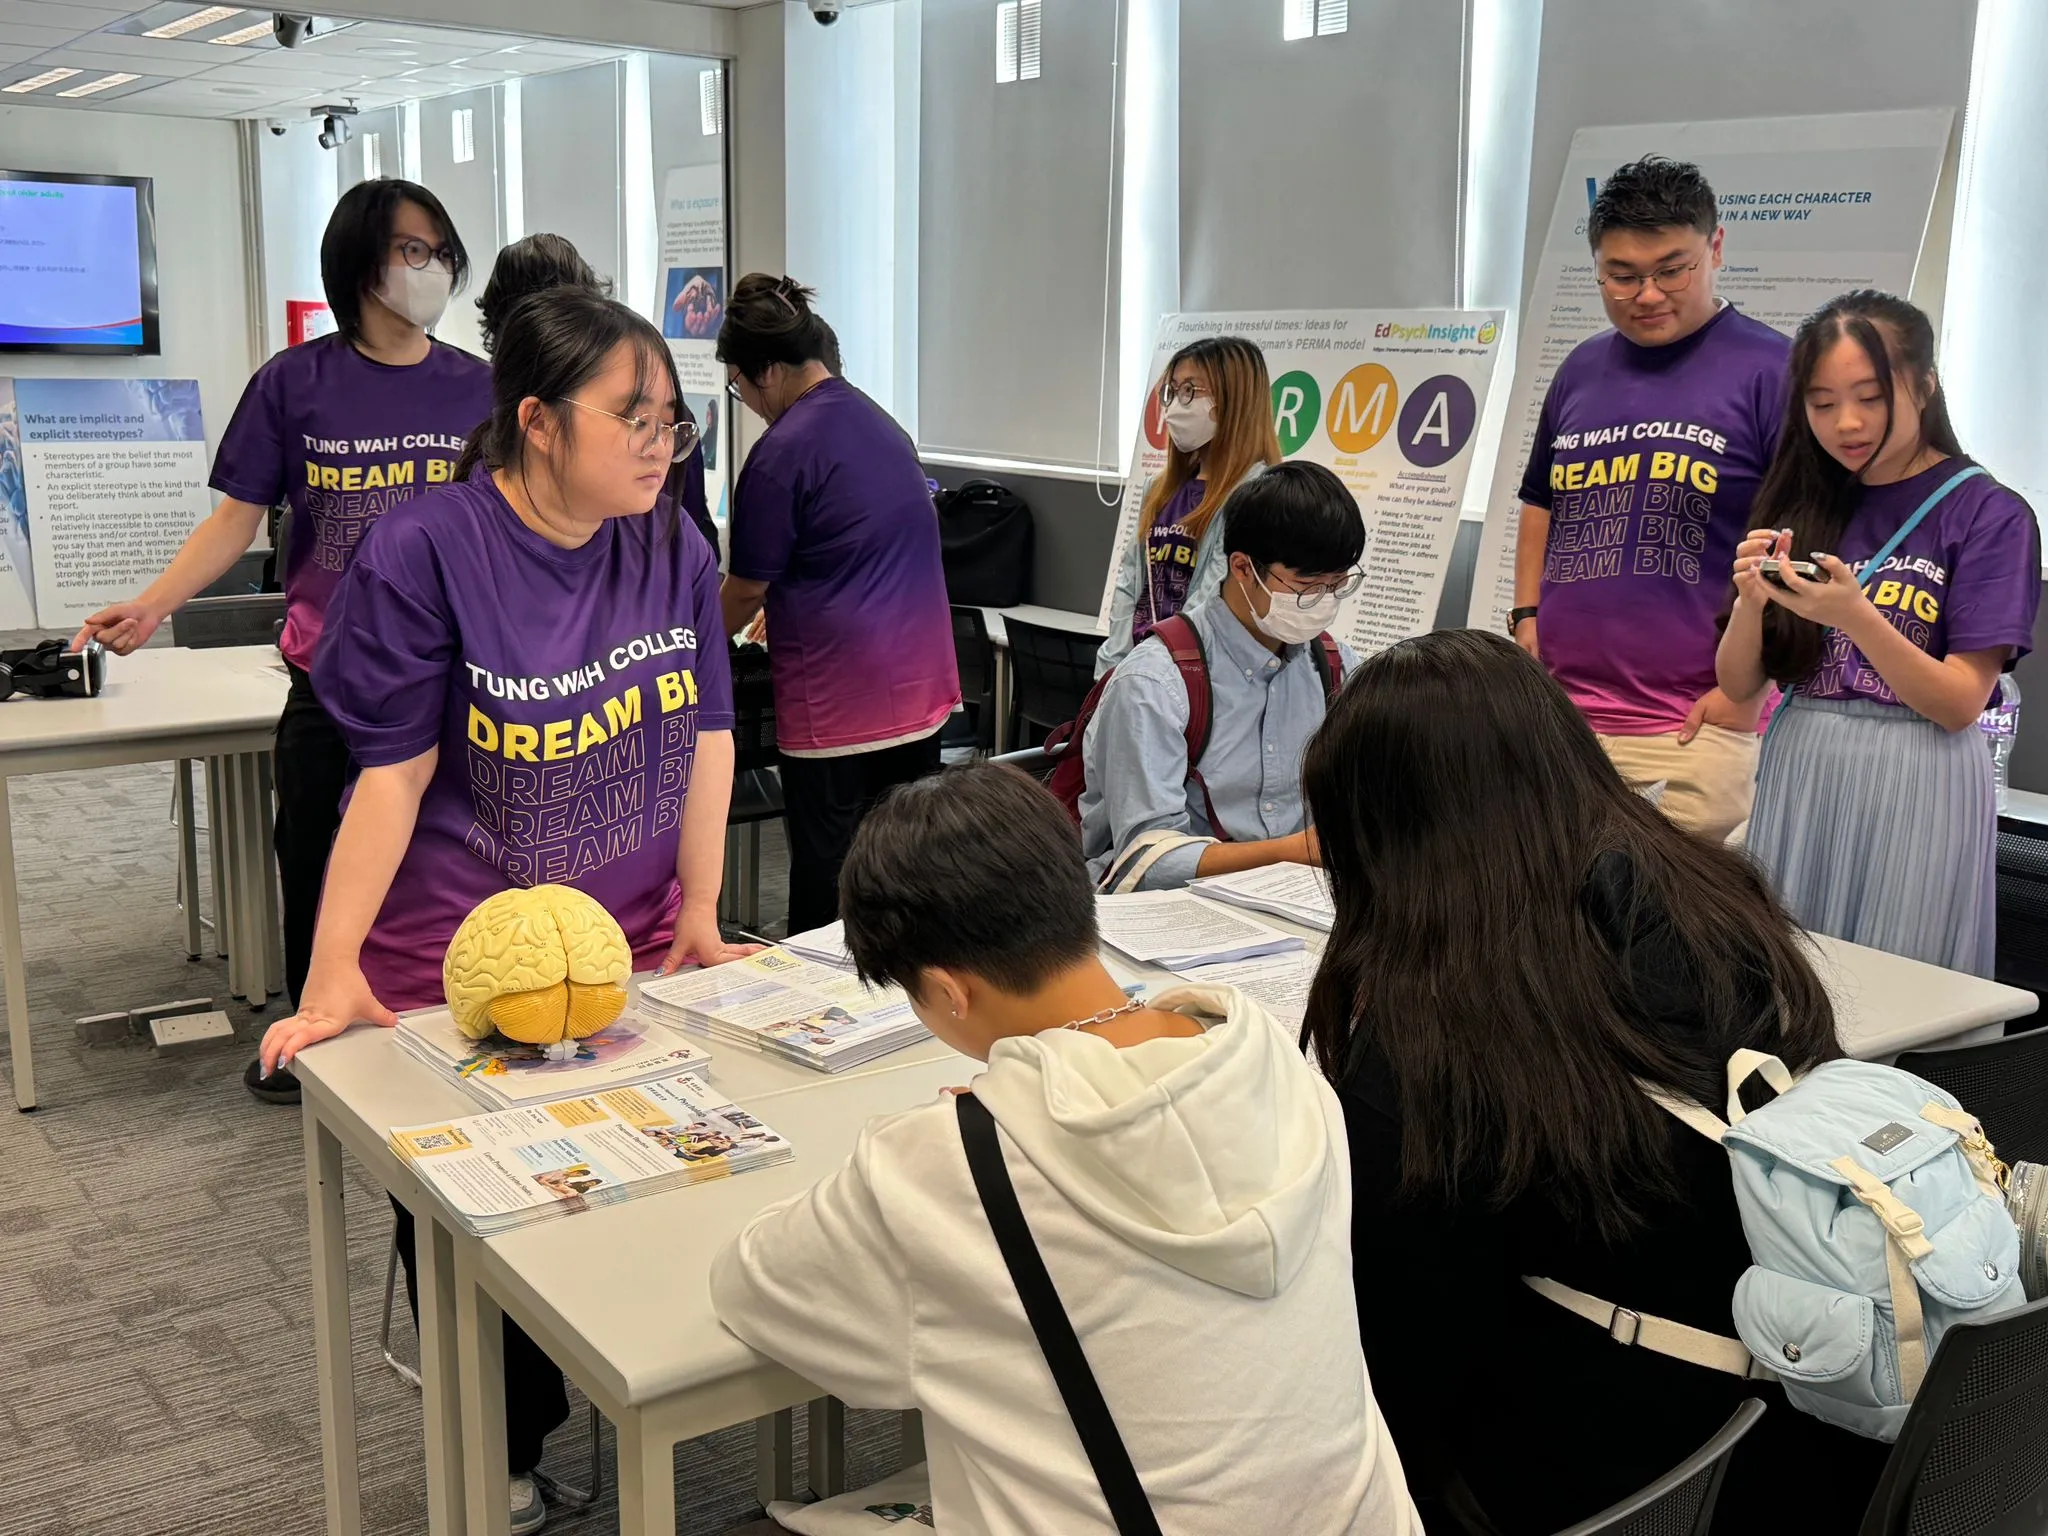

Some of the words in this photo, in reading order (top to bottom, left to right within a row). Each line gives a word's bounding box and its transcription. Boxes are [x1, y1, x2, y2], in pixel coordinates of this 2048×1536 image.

[1719, 195, 1756, 205] USING
[1759, 194, 1791, 204] EACH
[1795, 192, 1872, 204] CHARACTER
[1725, 211, 1737, 221] IN
[1739, 211, 1749, 220] A
[1751, 210, 1781, 220] NEW
[1784, 210, 1811, 220] WAY
[1178, 322, 1222, 333] Flourishing
[1224, 321, 1231, 330] in
[1234, 320, 1272, 331] stressful
[1274, 320, 1302, 331] times:
[1333, 319, 1348, 330] for
[1374, 323, 1476, 343] EdPsychInsight
[1296, 338, 1331, 350] PERMA
[1334, 338, 1365, 350] model
[24, 414, 57, 424] What
[59, 416, 77, 424] are
[80, 415, 121, 426] implicit
[124, 415, 144, 424] and
[1275, 386, 1304, 437] R
[1333, 382, 1389, 435] M
[1411, 391, 1450, 448] A
[30, 430, 70, 441] explicit
[72, 430, 143, 440] stereotypes?
[1583, 425, 1628, 448] WAH
[1632, 422, 1727, 455] COLLEGE
[303, 434, 349, 454] TUNG
[354, 437, 397, 453] WAH
[403, 434, 468, 452] COLLE
[44, 452, 95, 461] Stereotypes
[128, 451, 151, 459] belief
[153, 451, 170, 459] that
[45, 461, 85, 469] members
[87, 461, 96, 469] of
[105, 462, 130, 470] group
[46, 471, 104, 479] characteristic.
[305, 460, 414, 491] DREAM
[1551, 453, 1640, 490] REAM
[1650, 452, 1718, 494] BIG
[47, 483, 59, 491] An
[61, 482, 91, 492] explicit
[93, 482, 138, 491] stereotype
[1416, 485, 1429, 493] your
[1431, 486, 1451, 495] goals?
[48, 492, 64, 501] you
[66, 490, 116, 500] deliberately
[118, 490, 139, 499] think
[141, 490, 165, 498] about
[1403, 497, 1416, 505] they
[1551, 485, 1635, 522] REAM
[1643, 483, 1711, 524] BIG
[50, 514, 62, 522] An
[64, 513, 96, 522] implicit
[97, 513, 143, 522] stereotype
[51, 523, 90, 532] relatively
[92, 522, 142, 530] inaccessible
[99, 531, 127, 539] and/or
[1550, 517, 1629, 552] REAM
[1638, 515, 1705, 553] BIG
[54, 552, 84, 560] equally
[87, 551, 108, 559] good
[121, 549, 144, 558] math,
[54, 561, 72, 569] that
[74, 561, 90, 570] you
[92, 559, 130, 567] associate
[1546, 548, 1622, 583] REAM
[1633, 547, 1700, 584] BIG
[56, 570, 89, 578] strongly
[56, 579, 89, 588] actively
[91, 578, 117, 586] aware
[119, 577, 128, 585] of
[1873, 580, 1939, 624] BIG
[465, 661, 550, 701] TUNG
[552, 661, 606, 697] WAH
[609, 627, 697, 670] COLLEG
[1853, 668, 1891, 698] BI
[467, 685, 643, 763] DREAM
[656, 669, 699, 714] BI
[468, 728, 645, 806] DREAM
[660, 710, 699, 757] BI
[472, 772, 645, 848] DREAM
[656, 752, 694, 797] BI
[652, 792, 687, 837] BI
